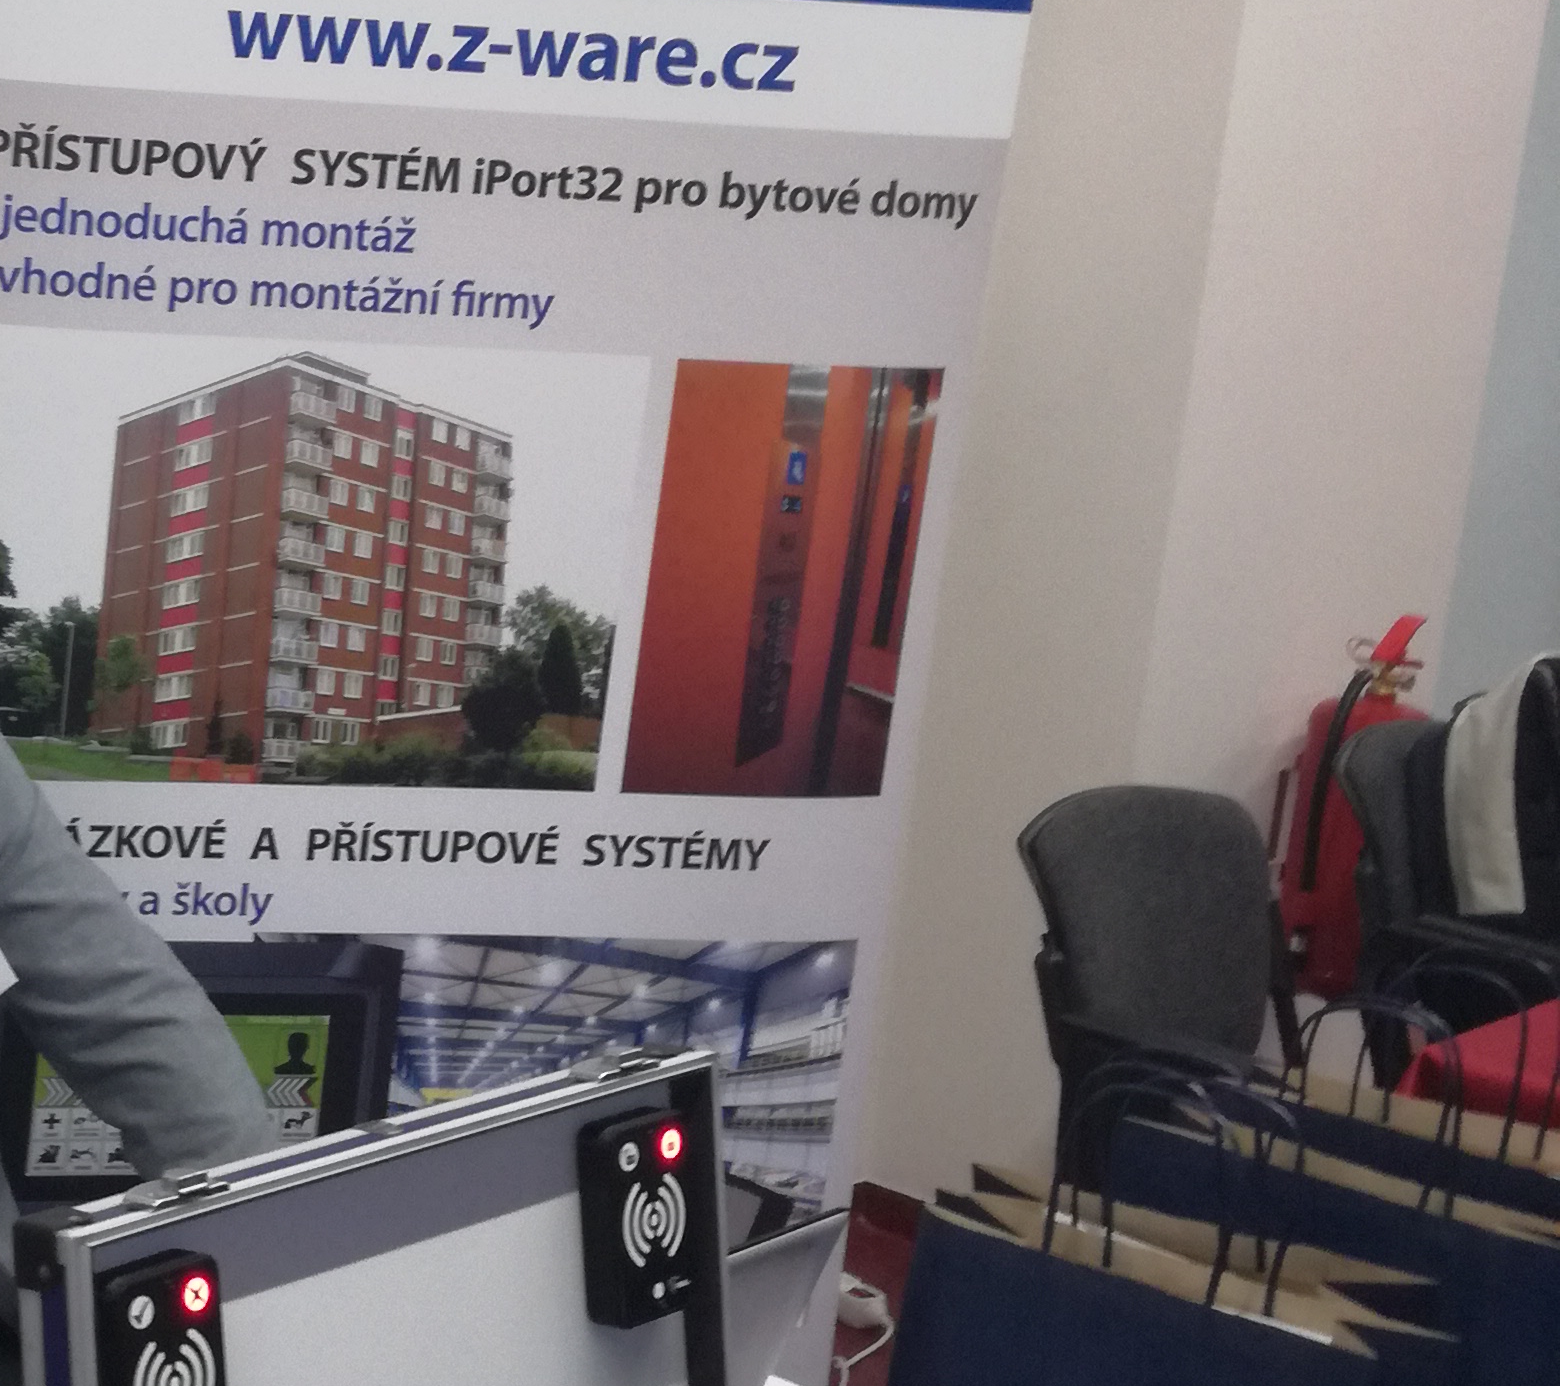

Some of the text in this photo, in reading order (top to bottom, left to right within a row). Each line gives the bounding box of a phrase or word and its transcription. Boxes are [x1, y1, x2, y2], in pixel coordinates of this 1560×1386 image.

[227, 9, 800, 92] www.z-ware.cz
[290, 145, 461, 194] SYSTÉM
[472, 158, 624, 203] iPort32
[634, 175, 709, 214] pro
[719, 170, 862, 220] bytové
[870, 180, 979, 230] domy
[260, 214, 416, 254] montáž
[167, 277, 239, 313] pro
[249, 276, 444, 317] montážní
[450, 280, 555, 329] firmy
[249, 827, 280, 860] A
[305, 820, 559, 866] PŘÍSTUPOVÉ
[582, 830, 771, 872] SYSTÉMY
[138, 880, 274, 927] a školy
